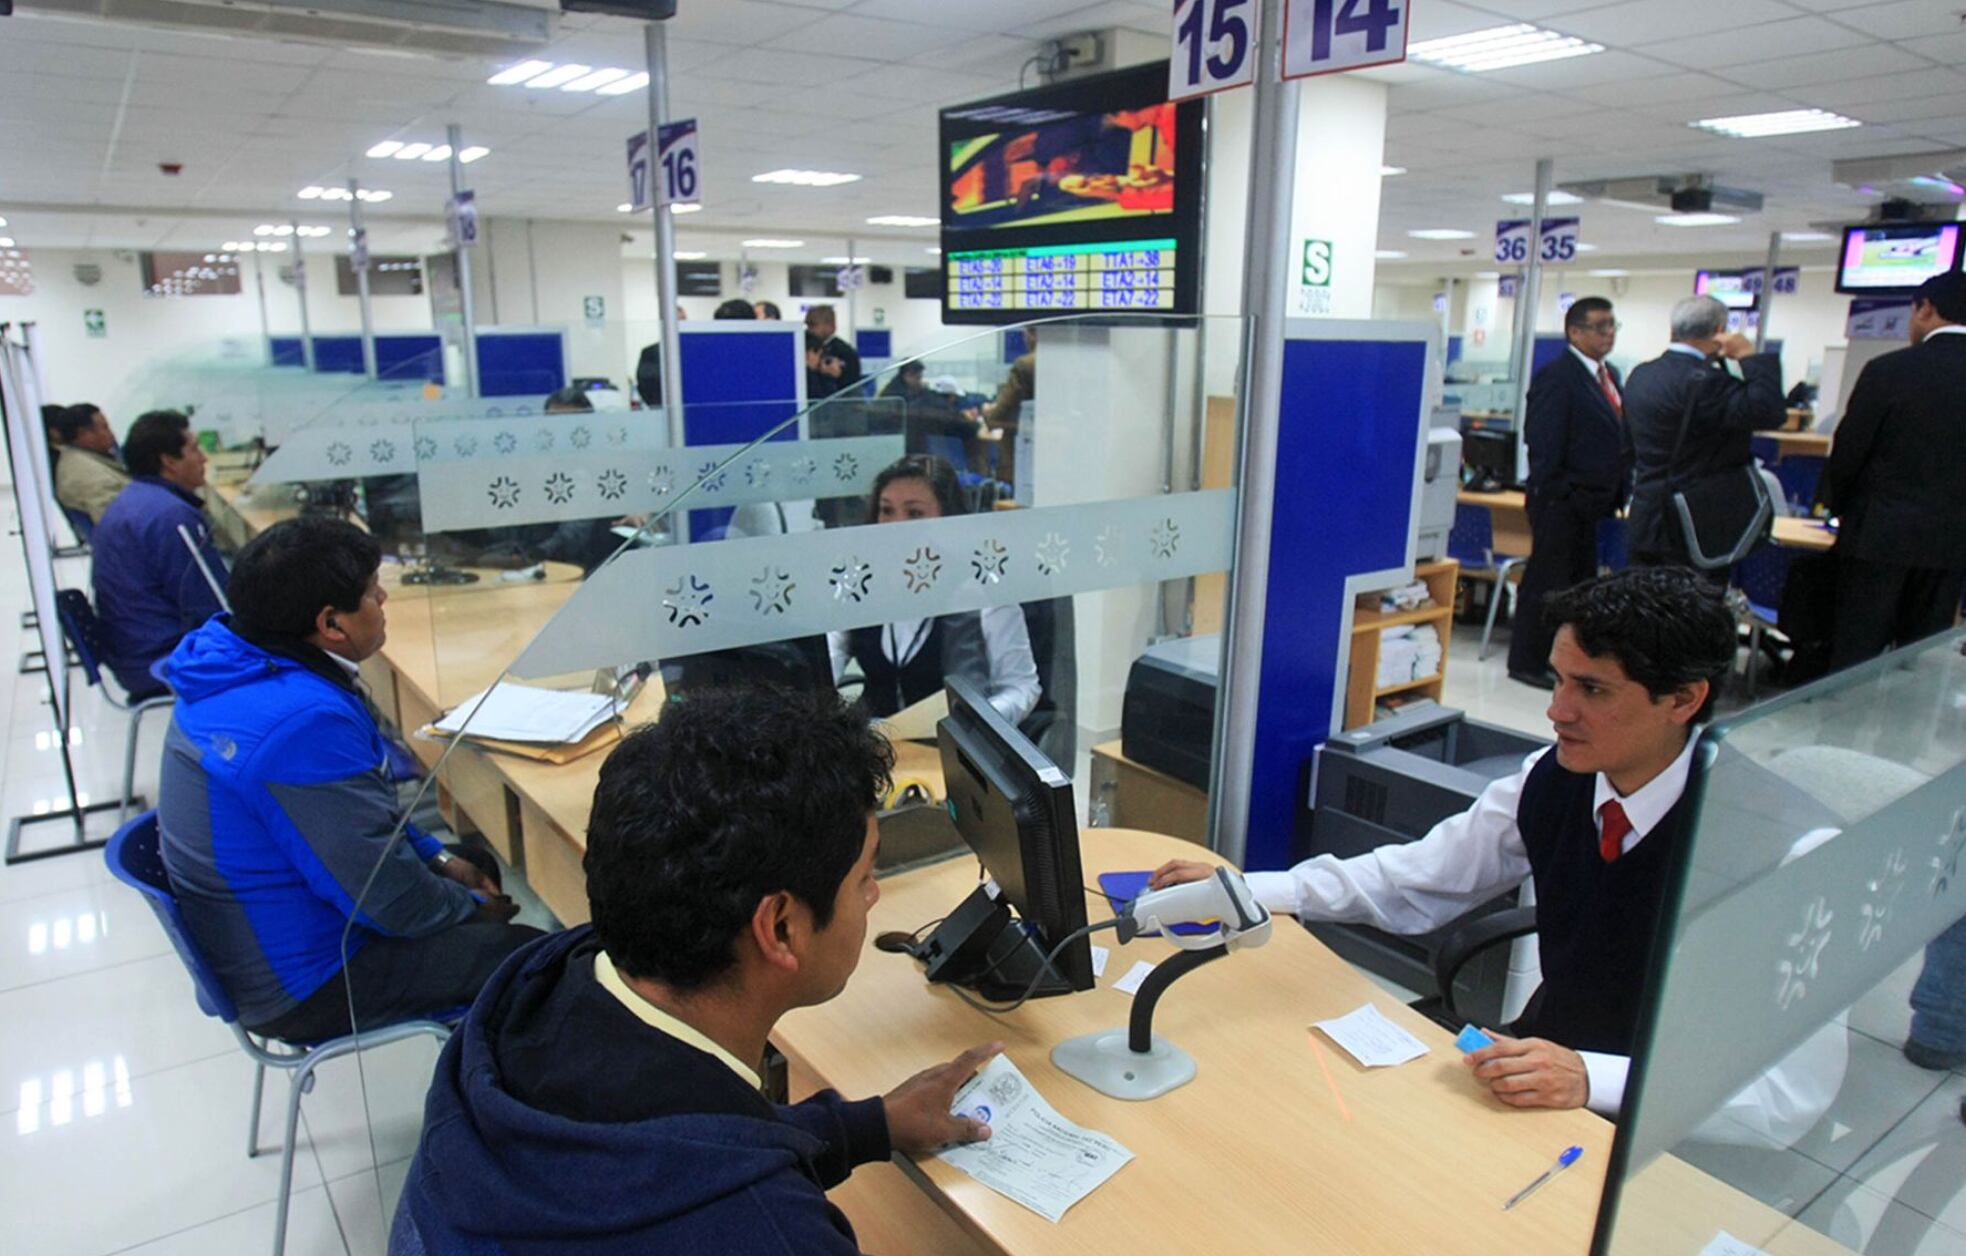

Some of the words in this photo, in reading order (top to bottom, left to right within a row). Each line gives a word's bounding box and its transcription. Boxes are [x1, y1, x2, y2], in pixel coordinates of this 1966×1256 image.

[1178, 0, 1248, 86] 15
[1311, 0, 1399, 61] 14
[630, 159, 646, 207] 17
[662, 148, 696, 198] 16
[1304, 240, 1330, 285] S
[1496, 237, 1526, 261] 36
[1541, 235, 1575, 260] 35
